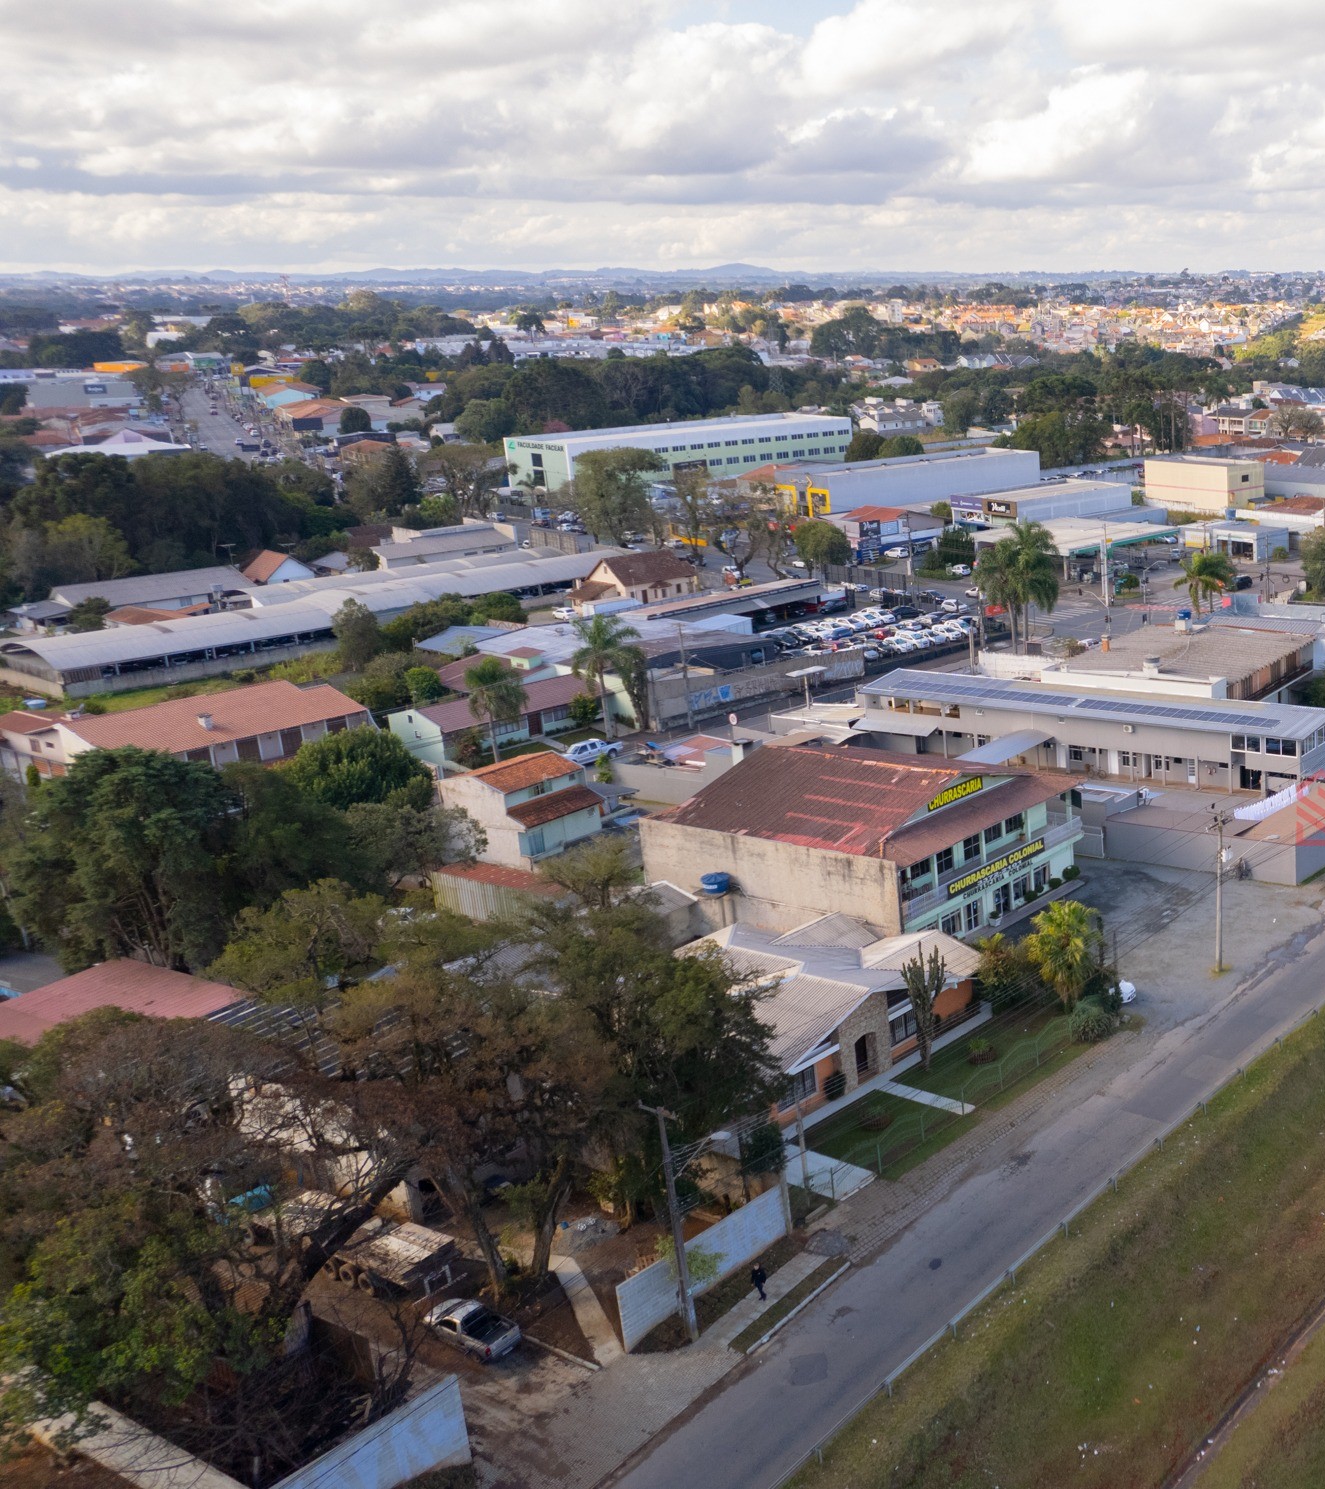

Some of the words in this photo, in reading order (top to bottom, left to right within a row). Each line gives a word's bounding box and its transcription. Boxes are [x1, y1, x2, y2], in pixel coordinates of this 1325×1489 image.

[517, 441, 544, 450] FACULDADE
[929, 777, 982, 810] CHURRASCARIA
[949, 858, 1008, 894] CHURRASCARIA
[1008, 840, 1044, 865] COLONIAL
[963, 874, 1005, 900] CHURRASCARIA
